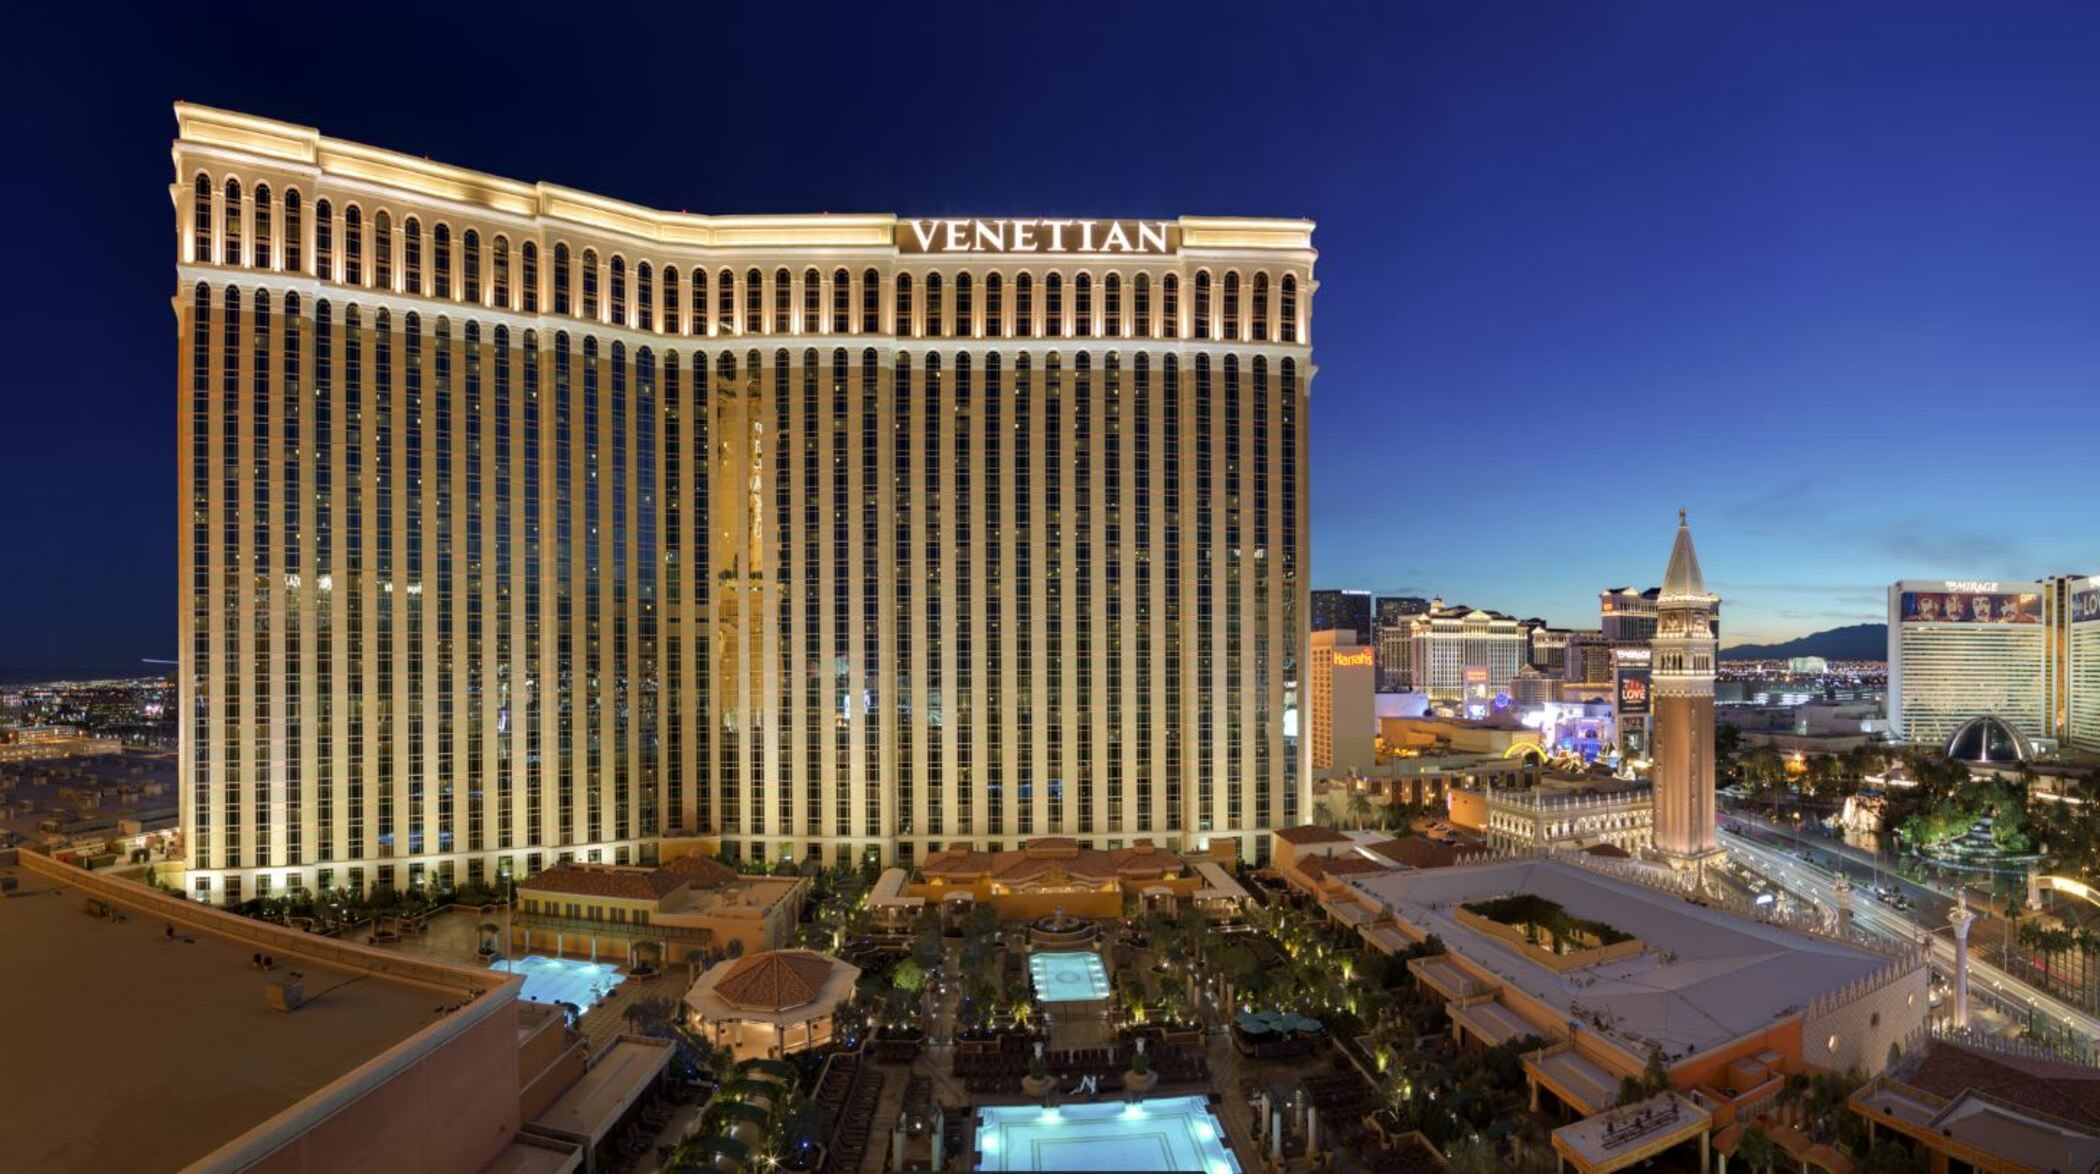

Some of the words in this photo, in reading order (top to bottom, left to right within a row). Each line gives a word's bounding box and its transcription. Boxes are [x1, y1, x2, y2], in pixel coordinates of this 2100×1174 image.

[911, 219, 1166, 252] VENETIAN
[1957, 581, 1999, 593] MIRAGE
[1622, 689, 1646, 700] LOVE
